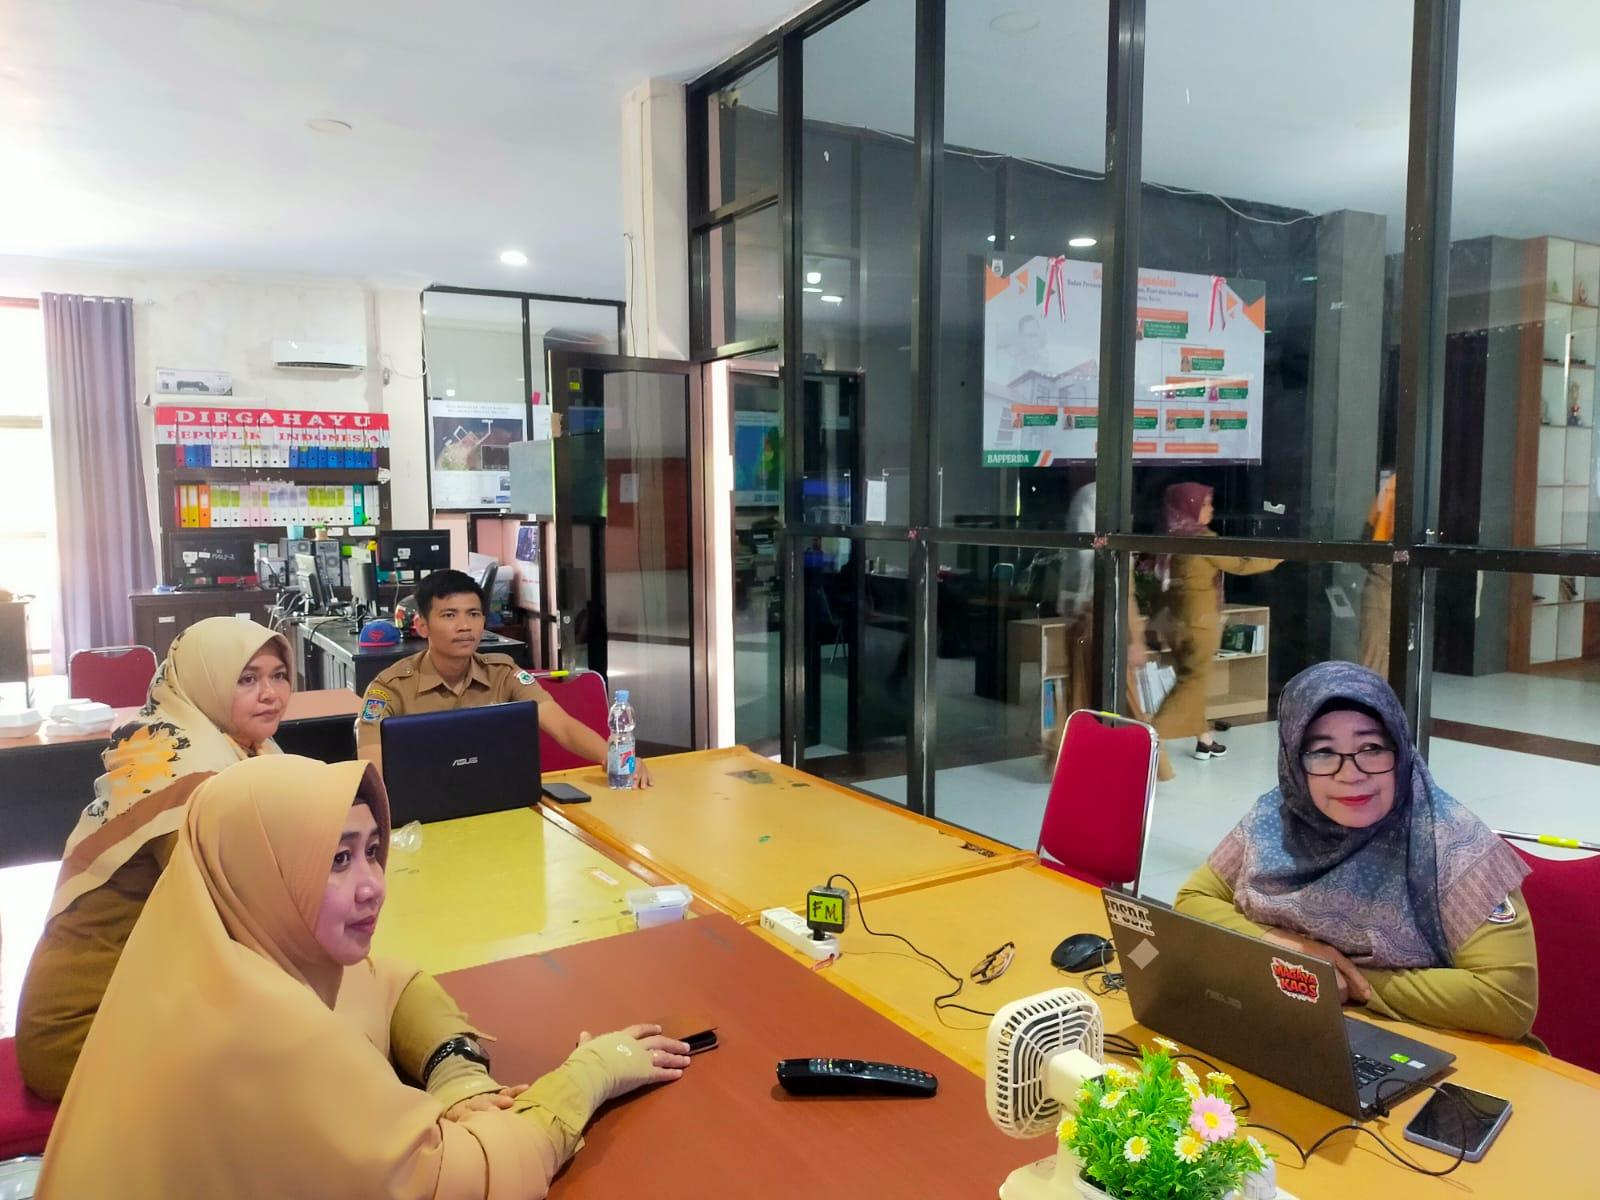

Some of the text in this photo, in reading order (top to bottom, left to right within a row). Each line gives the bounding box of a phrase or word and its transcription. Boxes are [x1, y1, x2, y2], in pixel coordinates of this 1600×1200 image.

[175, 410, 371, 427] DIRGAHAYU
[987, 453, 1030, 464] BAPPERIDA
[452, 756, 478, 767] ASUS
[812, 900, 838, 922] FM
[1280, 978, 1317, 998] KAOS
